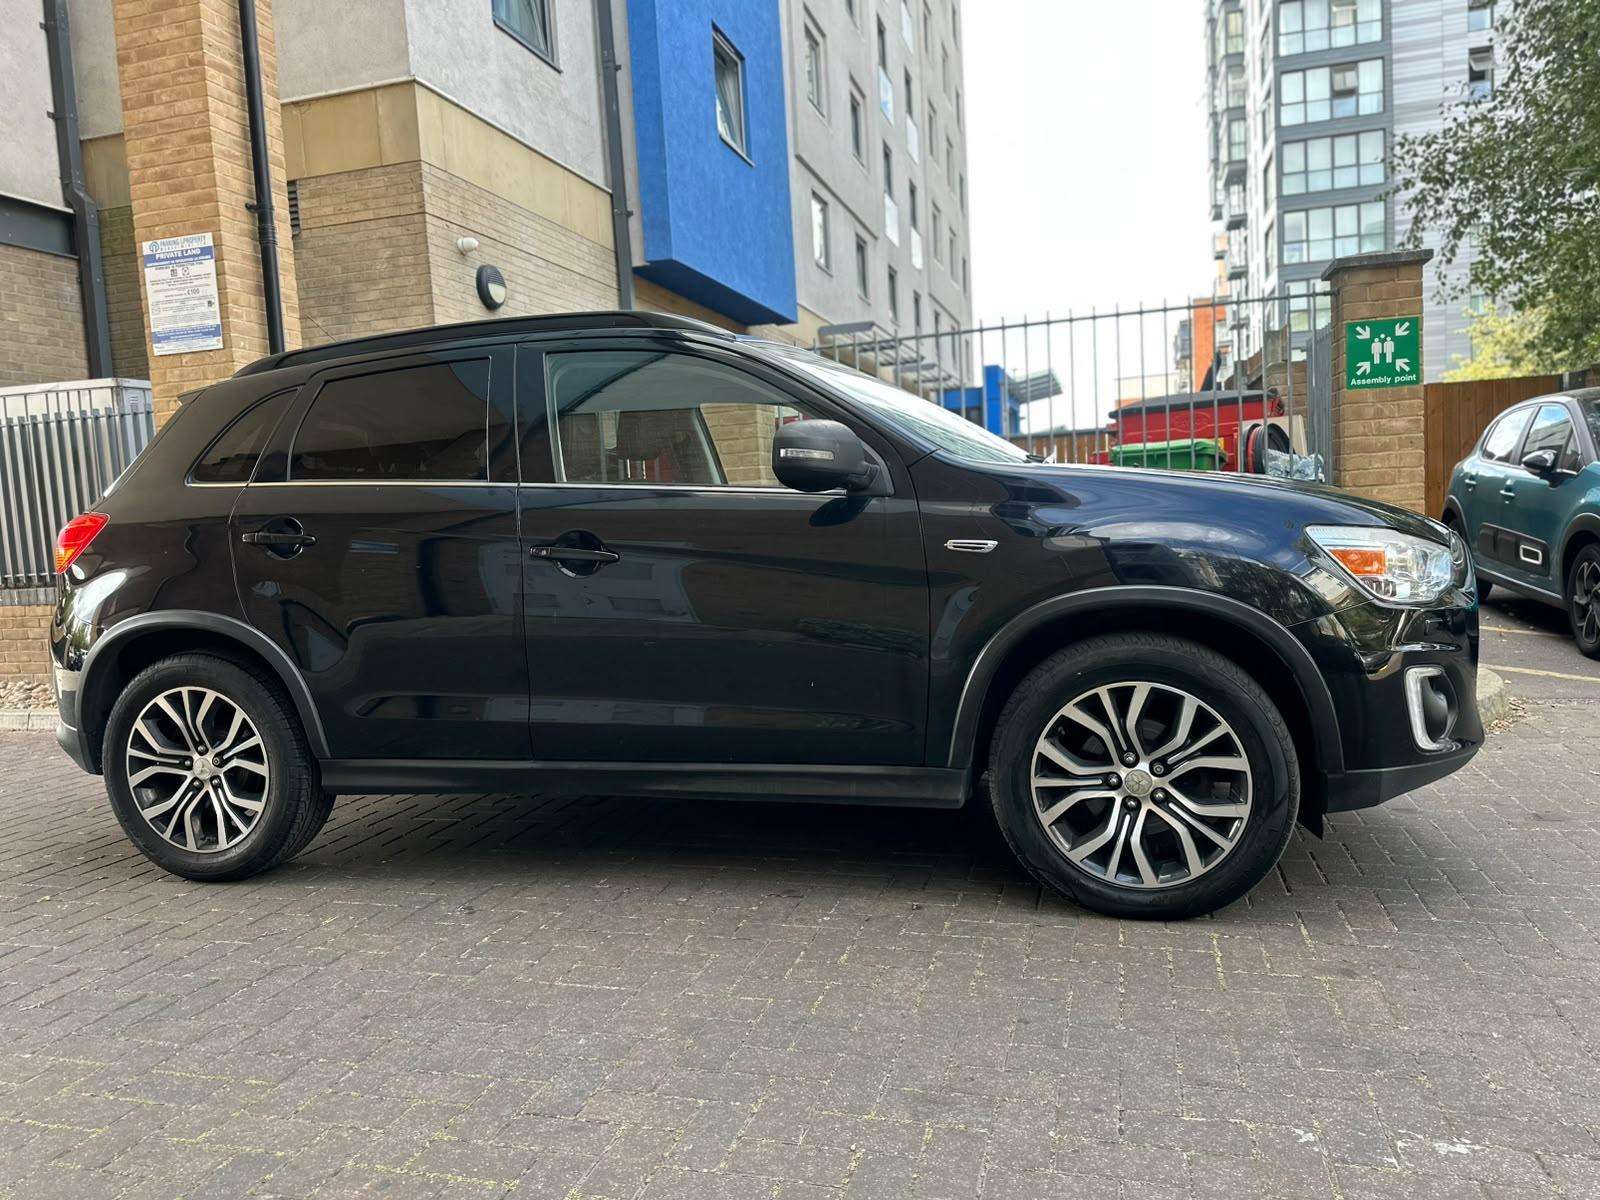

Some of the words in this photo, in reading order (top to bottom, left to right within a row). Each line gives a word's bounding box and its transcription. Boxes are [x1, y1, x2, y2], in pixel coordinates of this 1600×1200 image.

[155, 251, 183, 260] PRIVATE
[183, 248, 201, 256] LAND
[1350, 375, 1392, 386] Assembly
[1394, 374, 1417, 383] point
